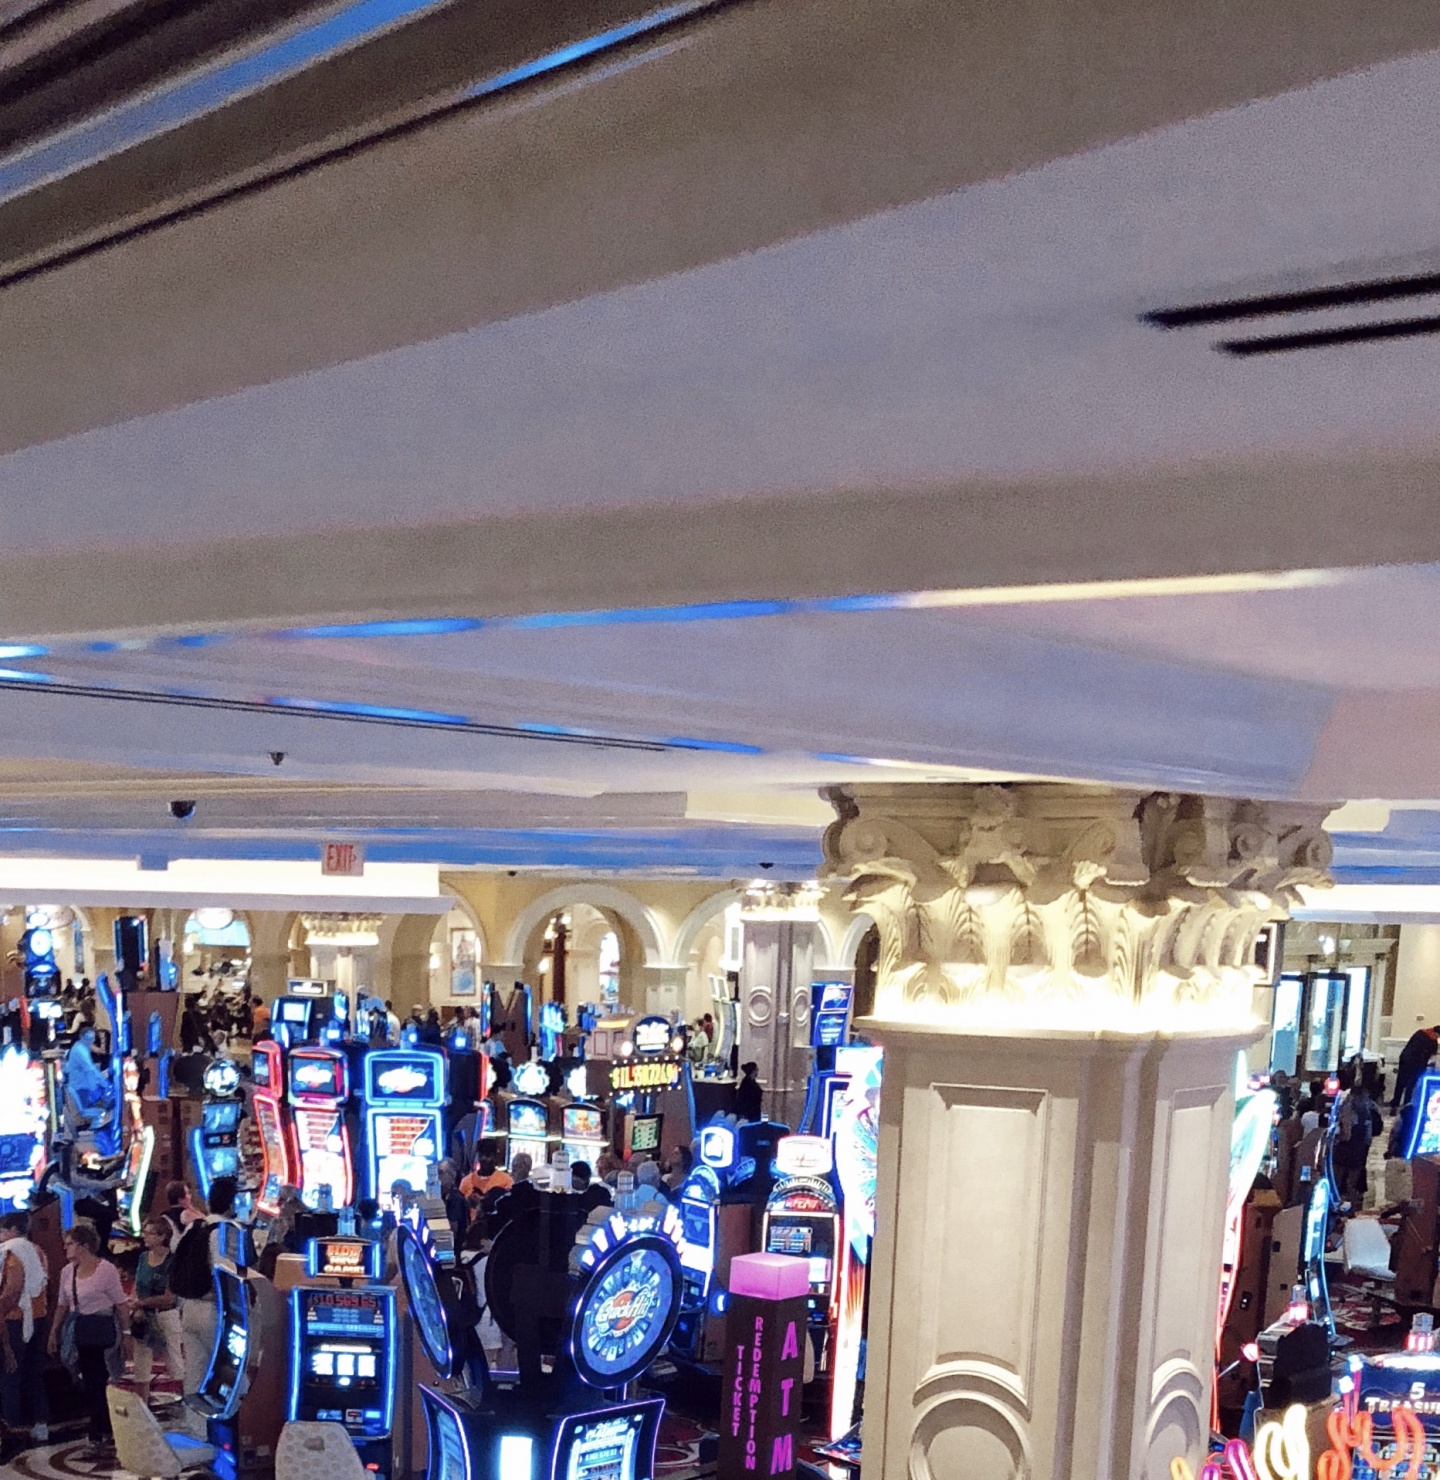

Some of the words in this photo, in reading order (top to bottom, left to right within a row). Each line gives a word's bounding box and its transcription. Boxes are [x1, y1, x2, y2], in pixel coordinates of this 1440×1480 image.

[327, 844, 353, 871] EXIT
[732, 1345, 745, 1437] TICKET
[745, 1316, 764, 1470] REDEMPTION
[770, 1321, 798, 1475] ATM
[1410, 1382, 1426, 1399] 5
